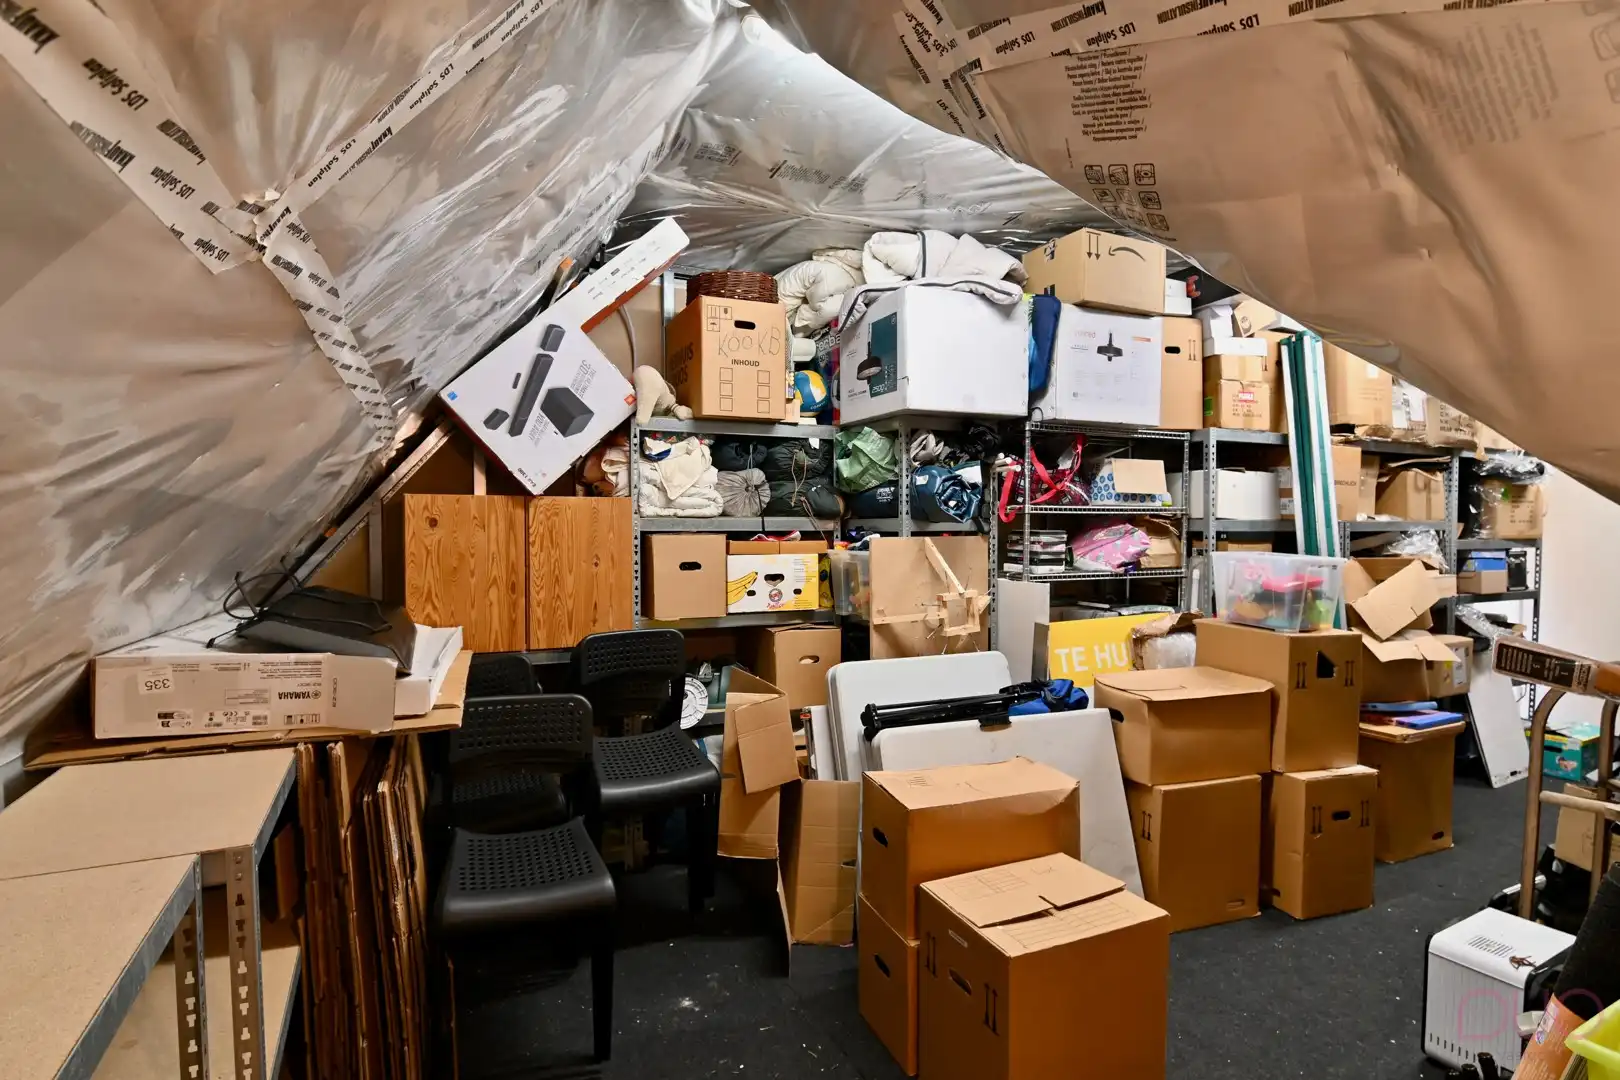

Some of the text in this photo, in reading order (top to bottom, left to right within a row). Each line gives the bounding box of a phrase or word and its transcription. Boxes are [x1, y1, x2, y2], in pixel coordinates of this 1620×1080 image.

[995, 31, 1036, 55] LDS Soliplan
[1086, 22, 1137, 48] LDS Soliplan
[82, 57, 149, 111] LDS Soliplan
[409, 62, 455, 111] LDS Soliplan
[150, 165, 196, 200] LDS Soliplan
[307, 155, 340, 188] Soliplan
[213, 248, 231, 263] LDS
[731, 358, 760, 367] INHOUD
[1055, 646, 1089, 674] TE
[144, 677, 171, 693] 335
[278, 690, 312, 700] YAMAHA
